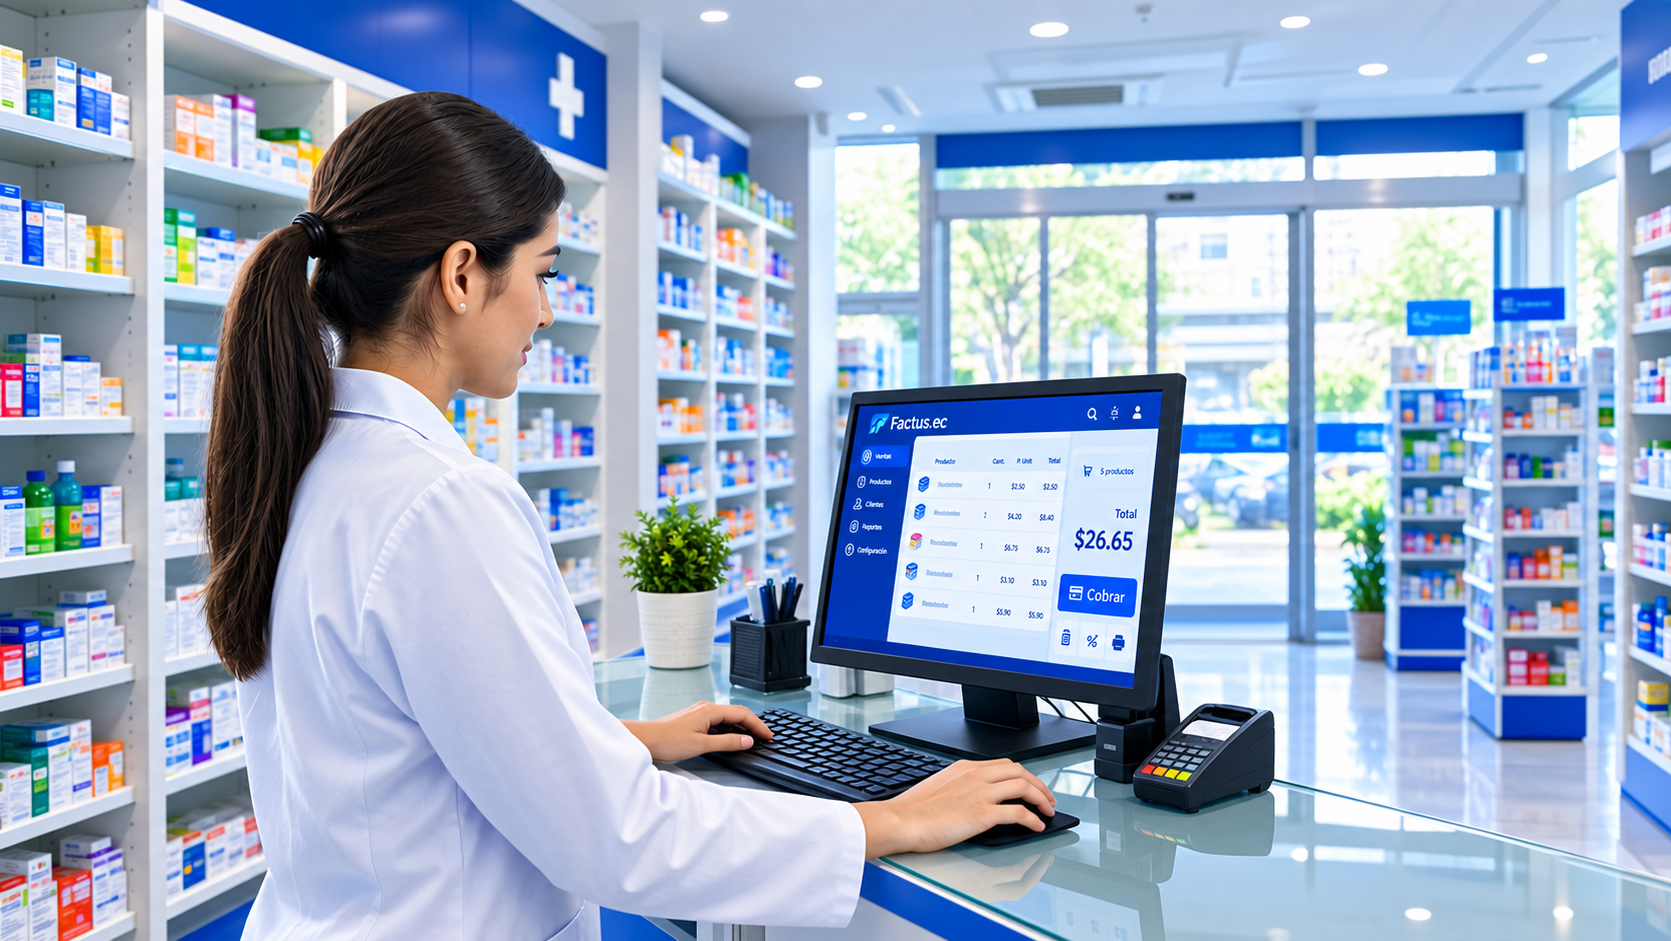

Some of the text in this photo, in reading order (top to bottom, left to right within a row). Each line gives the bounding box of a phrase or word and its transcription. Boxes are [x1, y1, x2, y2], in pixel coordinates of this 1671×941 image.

[890, 416, 948, 431] Factus.ec
[992, 457, 1005, 465] Cant.
[1048, 457, 1062, 465] Total
[1099, 467, 1134, 477] 5 productos
[1011, 483, 1026, 491] $2.50
[1043, 483, 1059, 491] $2.50
[1115, 508, 1138, 519] Total
[1074, 527, 1133, 552] $26.65
[1004, 543, 1019, 552] $6.75
[1036, 545, 1051, 554] $6.75
[1087, 588, 1126, 604] Cobrar
[1028, 610, 1044, 619] $5.90
